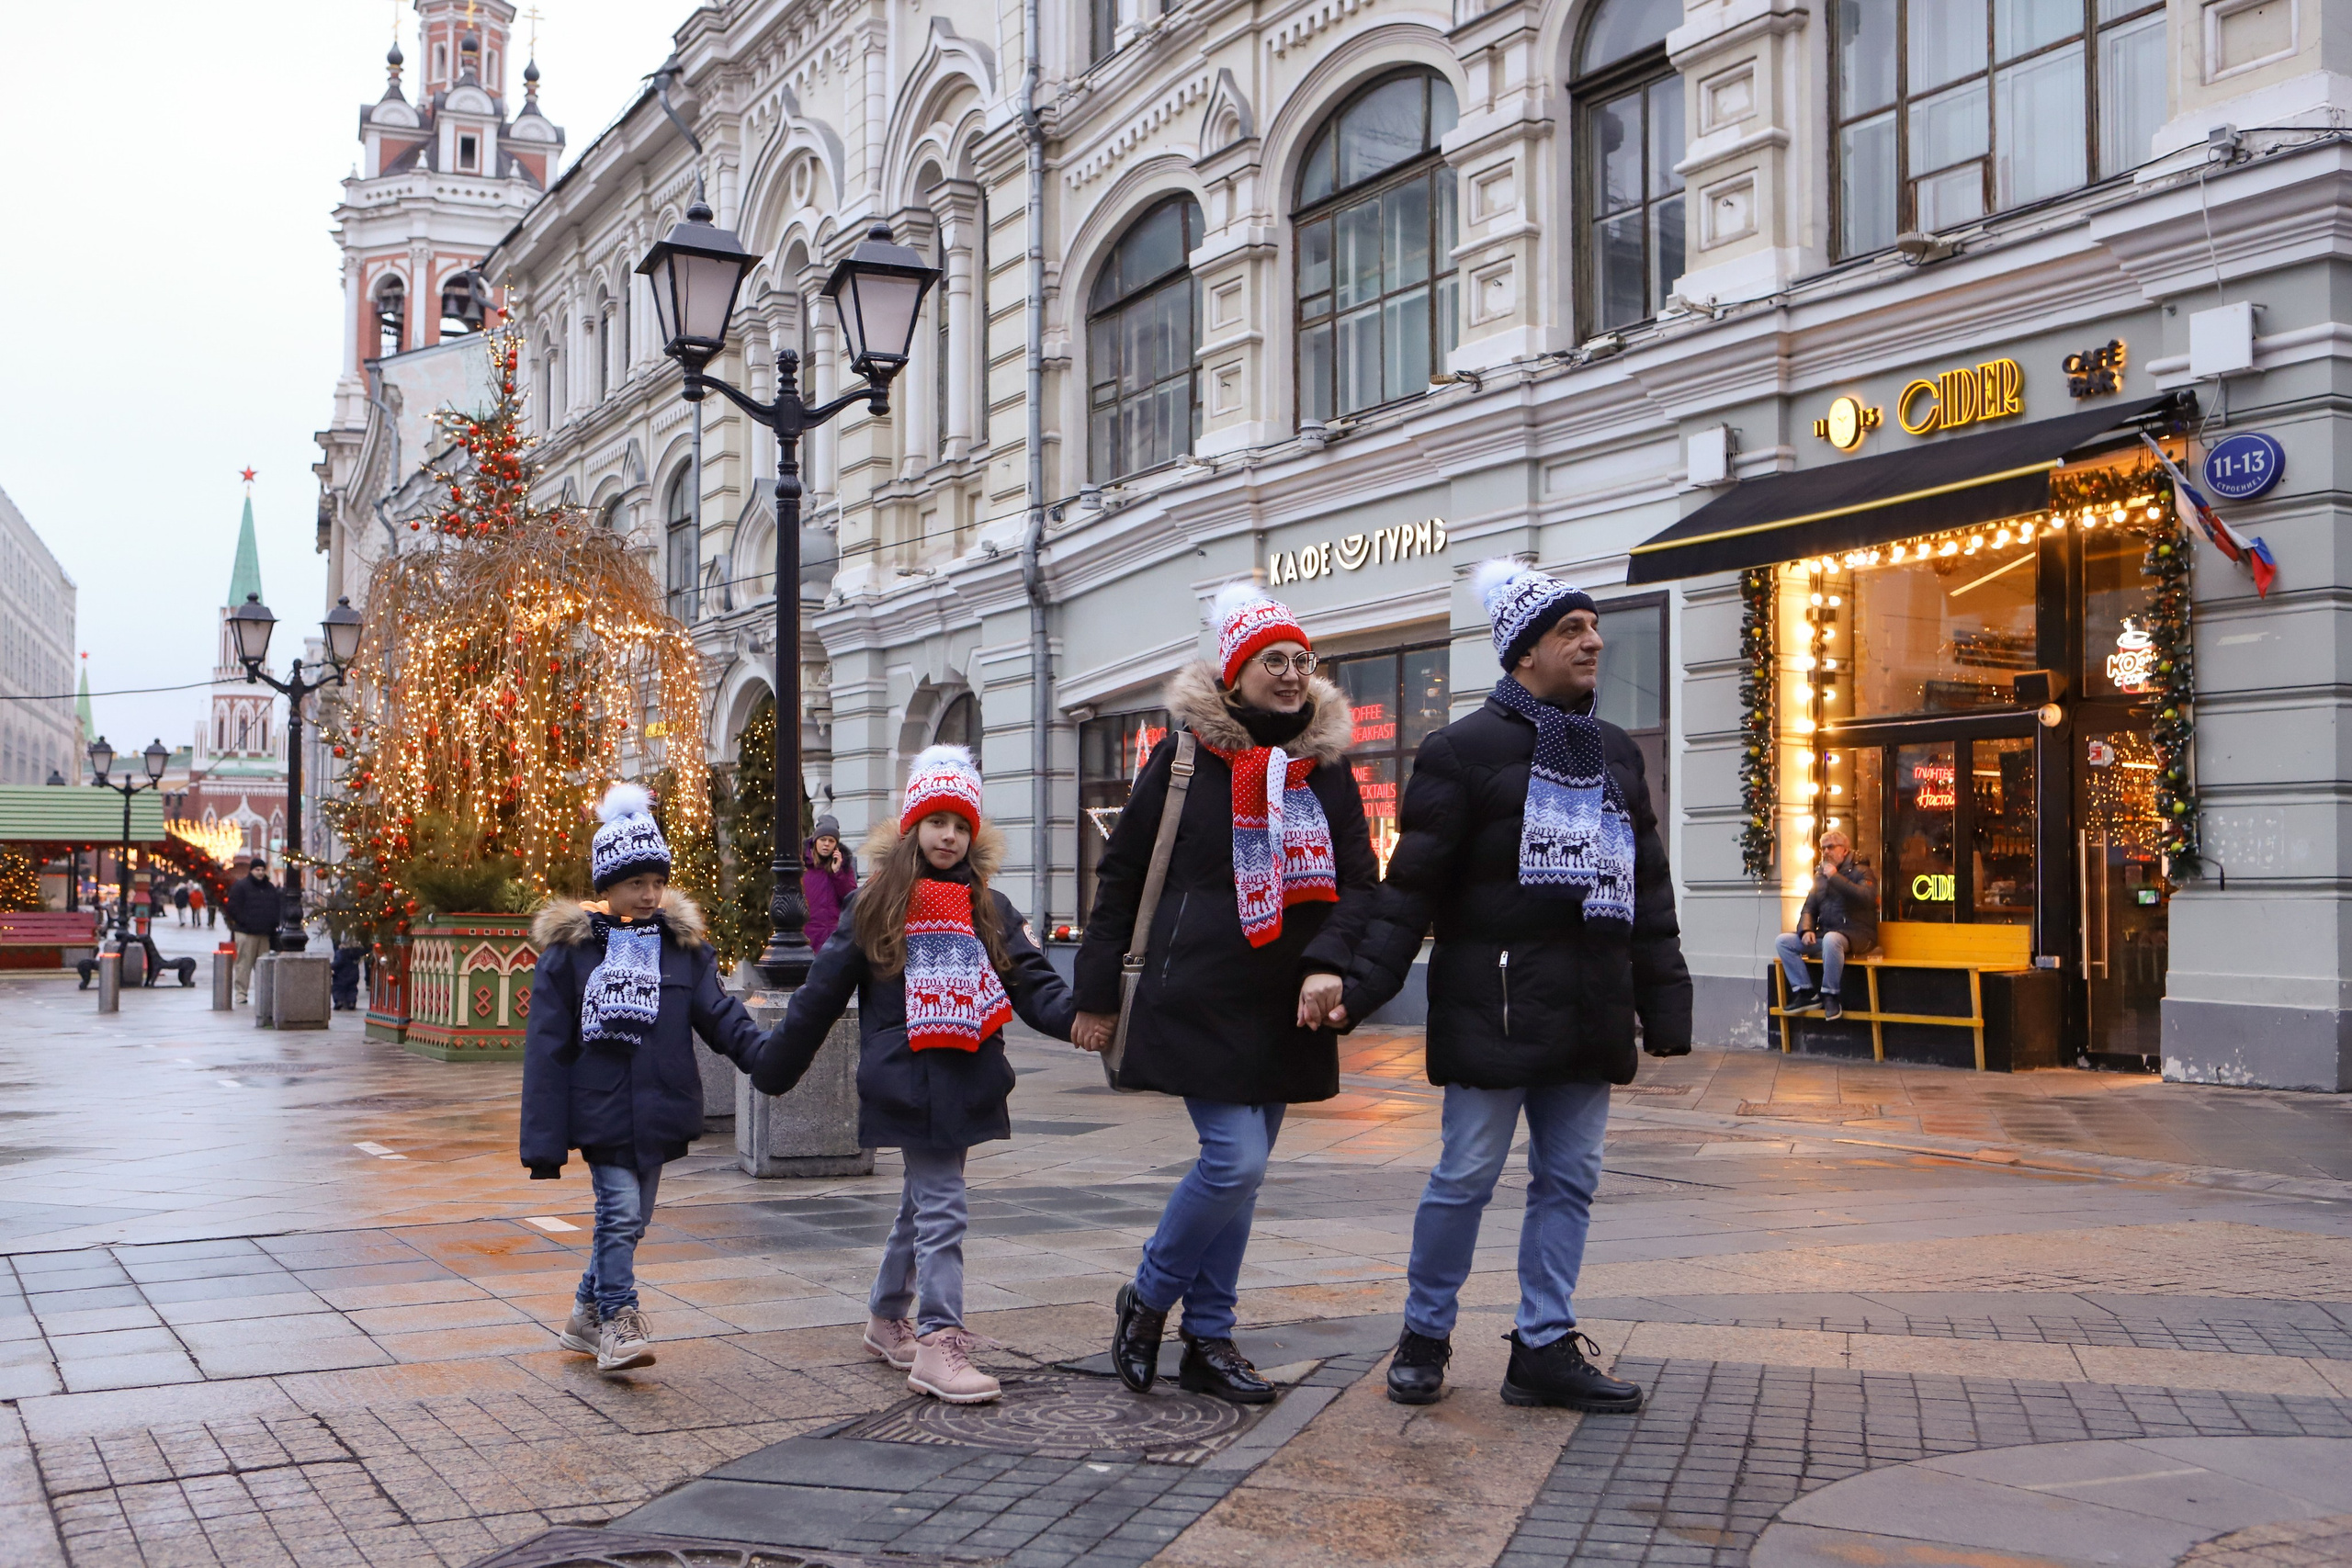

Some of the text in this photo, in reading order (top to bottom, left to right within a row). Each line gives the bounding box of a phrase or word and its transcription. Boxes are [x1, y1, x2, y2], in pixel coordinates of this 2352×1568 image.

[2069, 369, 2118, 398] BAR
[1897, 357, 2021, 435] CIDER
[2213, 450, 2265, 478] 11-13
[2216, 479, 2257, 492] СТРОЕНИЕ
[1270, 542, 1332, 585] КАФЕ
[1348, 704, 1382, 722] OFFEE
[1351, 722, 1396, 743] REAKFAST
[1351, 766, 1369, 782] INE
[1914, 766, 1955, 780] ГЛИНТВЕ
[1359, 783, 1396, 800] CKTAILS
